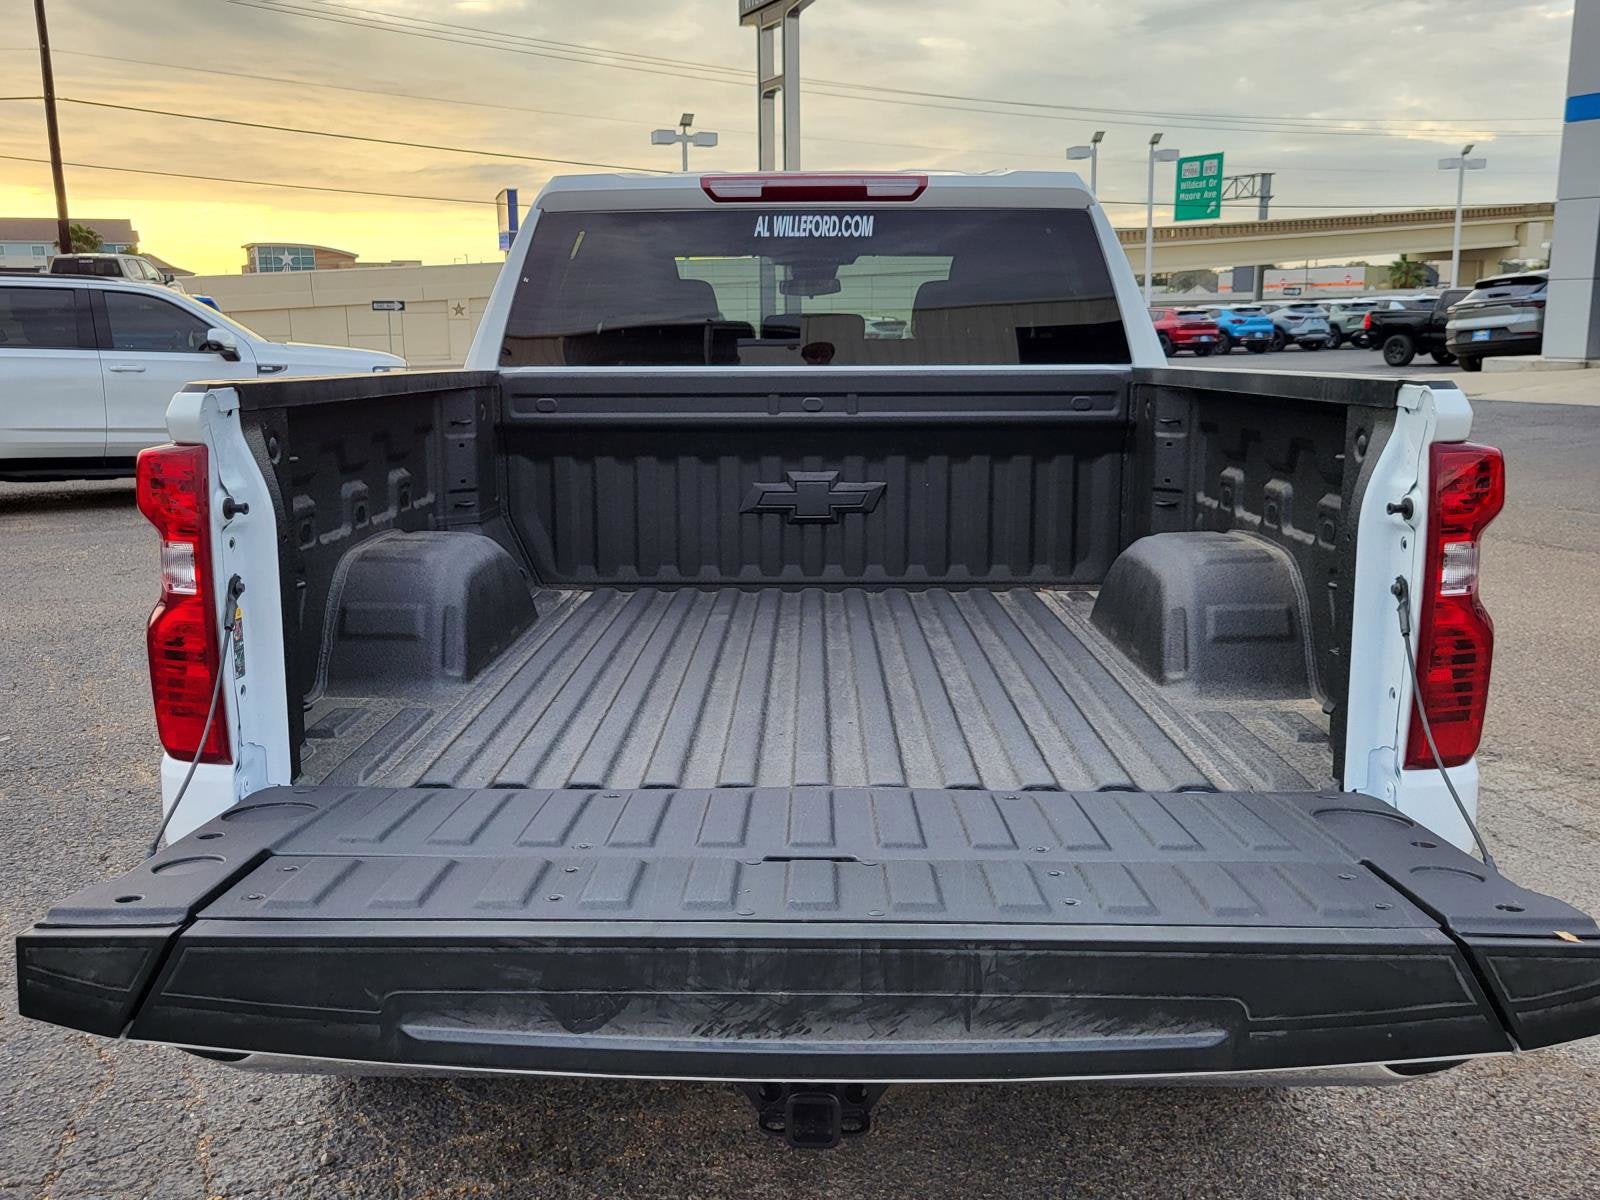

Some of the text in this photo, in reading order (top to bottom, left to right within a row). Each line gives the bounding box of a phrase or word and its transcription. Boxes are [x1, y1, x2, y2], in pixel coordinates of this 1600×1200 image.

[1180, 178, 1218, 190] Wildcat Dr
[1179, 190, 1217, 200] Moore Ave
[754, 215, 874, 237] AL WILLEFORD.COM
